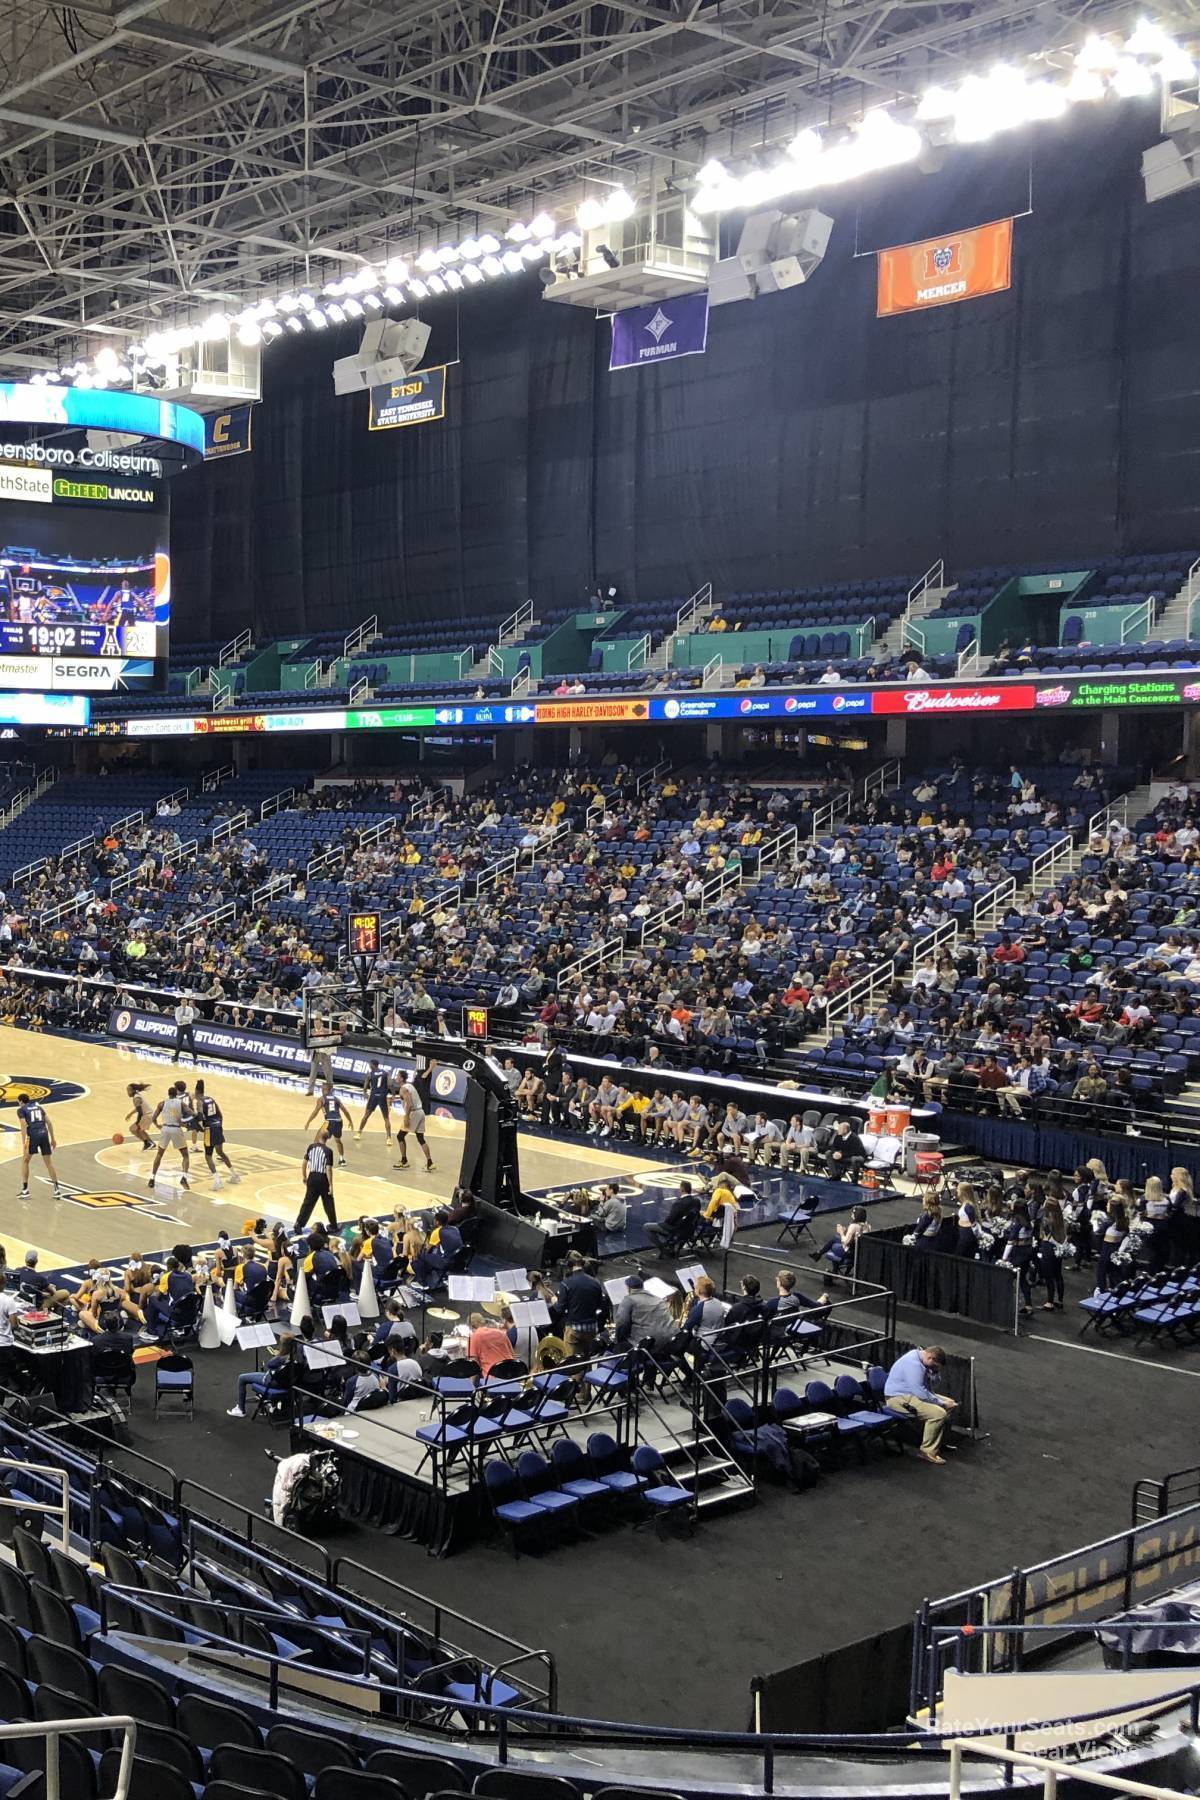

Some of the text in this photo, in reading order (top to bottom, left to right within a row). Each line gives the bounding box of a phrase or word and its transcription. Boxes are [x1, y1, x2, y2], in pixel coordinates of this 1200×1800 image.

[917, 281, 966, 300] MERCER
[640, 342, 677, 358] FURMAN
[392, 382, 422, 398] ETSU
[380, 400, 433, 417] EAST TENNESSEE
[377, 408, 435, 426] STATE UNIVERSITY
[213, 415, 231, 442] C
[81, 449, 157, 473] Coliseum
[54, 479, 154, 503] GREEN LINCOLN
[28, 626, 76, 646] 19:02
[55, 666, 110, 677] SEGRA
[1078, 685, 1126, 695] Charging
[1128, 683, 1174, 692] Stations
[752, 702, 769, 711] pepsi
[797, 701, 816, 710] pepsi
[845, 699, 864, 708] pepsi
[904, 691, 1000, 711] Budweiser
[1103, 696, 1127, 704] Main
[1129, 695, 1180, 703] Concourse
[537, 707, 555, 719] RIDING
[557, 706, 570, 717] HIGH
[353, 917, 376, 928] 19:02
[195, 1031, 294, 1061] STUDENT-ATHLETE
[392, 1040, 413, 1048] SPALDING
[377, 1076, 381, 1088] 1
[31, 1110, 42, 1122] 14
